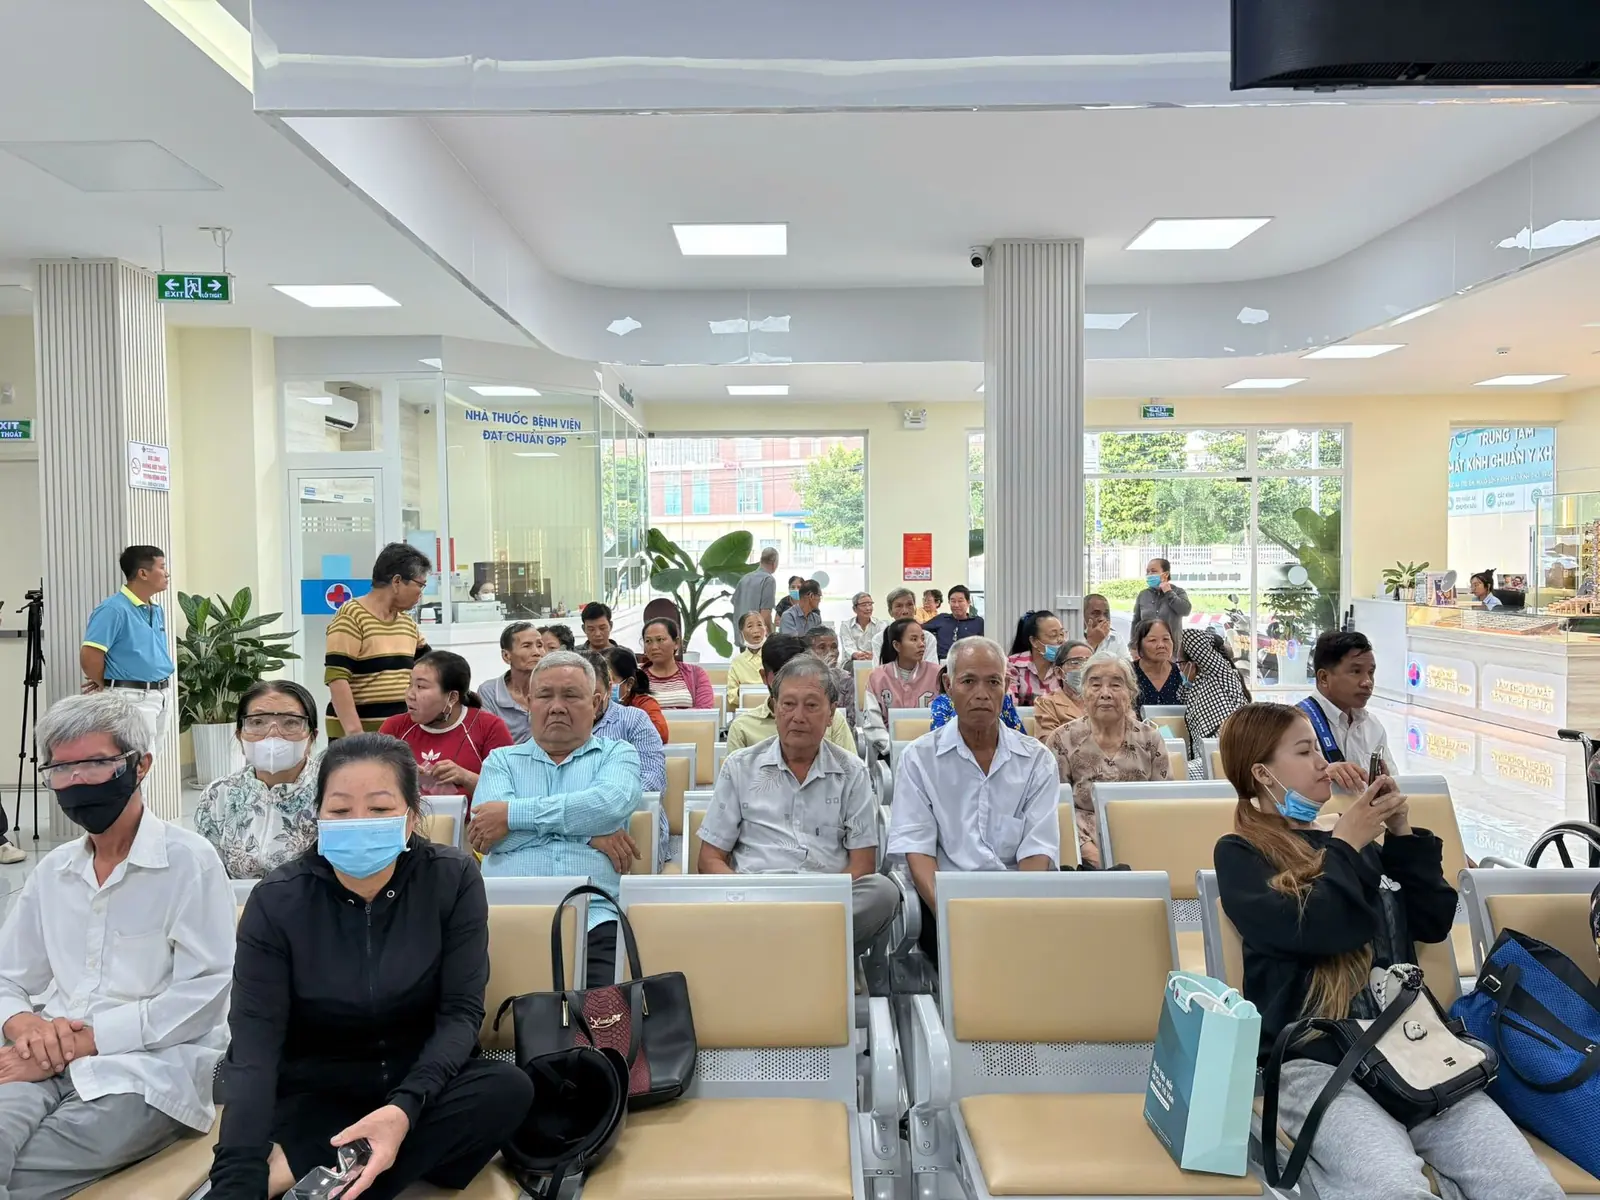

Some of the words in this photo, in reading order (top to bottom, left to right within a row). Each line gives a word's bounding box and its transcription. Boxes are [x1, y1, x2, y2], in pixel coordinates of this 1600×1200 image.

[164, 290, 184, 298] EXIT
[465, 409, 489, 422] NHÀ
[492, 410, 529, 425] THUỐC
[532, 415, 558, 430] BỆNH
[560, 418, 581, 432] VIỆN
[1, 430, 23, 438] THOÁT
[482, 430, 503, 444] ĐẠT
[506, 429, 544, 445] CHUẨN
[547, 435, 567, 446] GPP
[1479, 428, 1511, 446] TRUNG
[1467, 453, 1490, 471] KÍNH
[1528, 448, 1536, 463] Y
